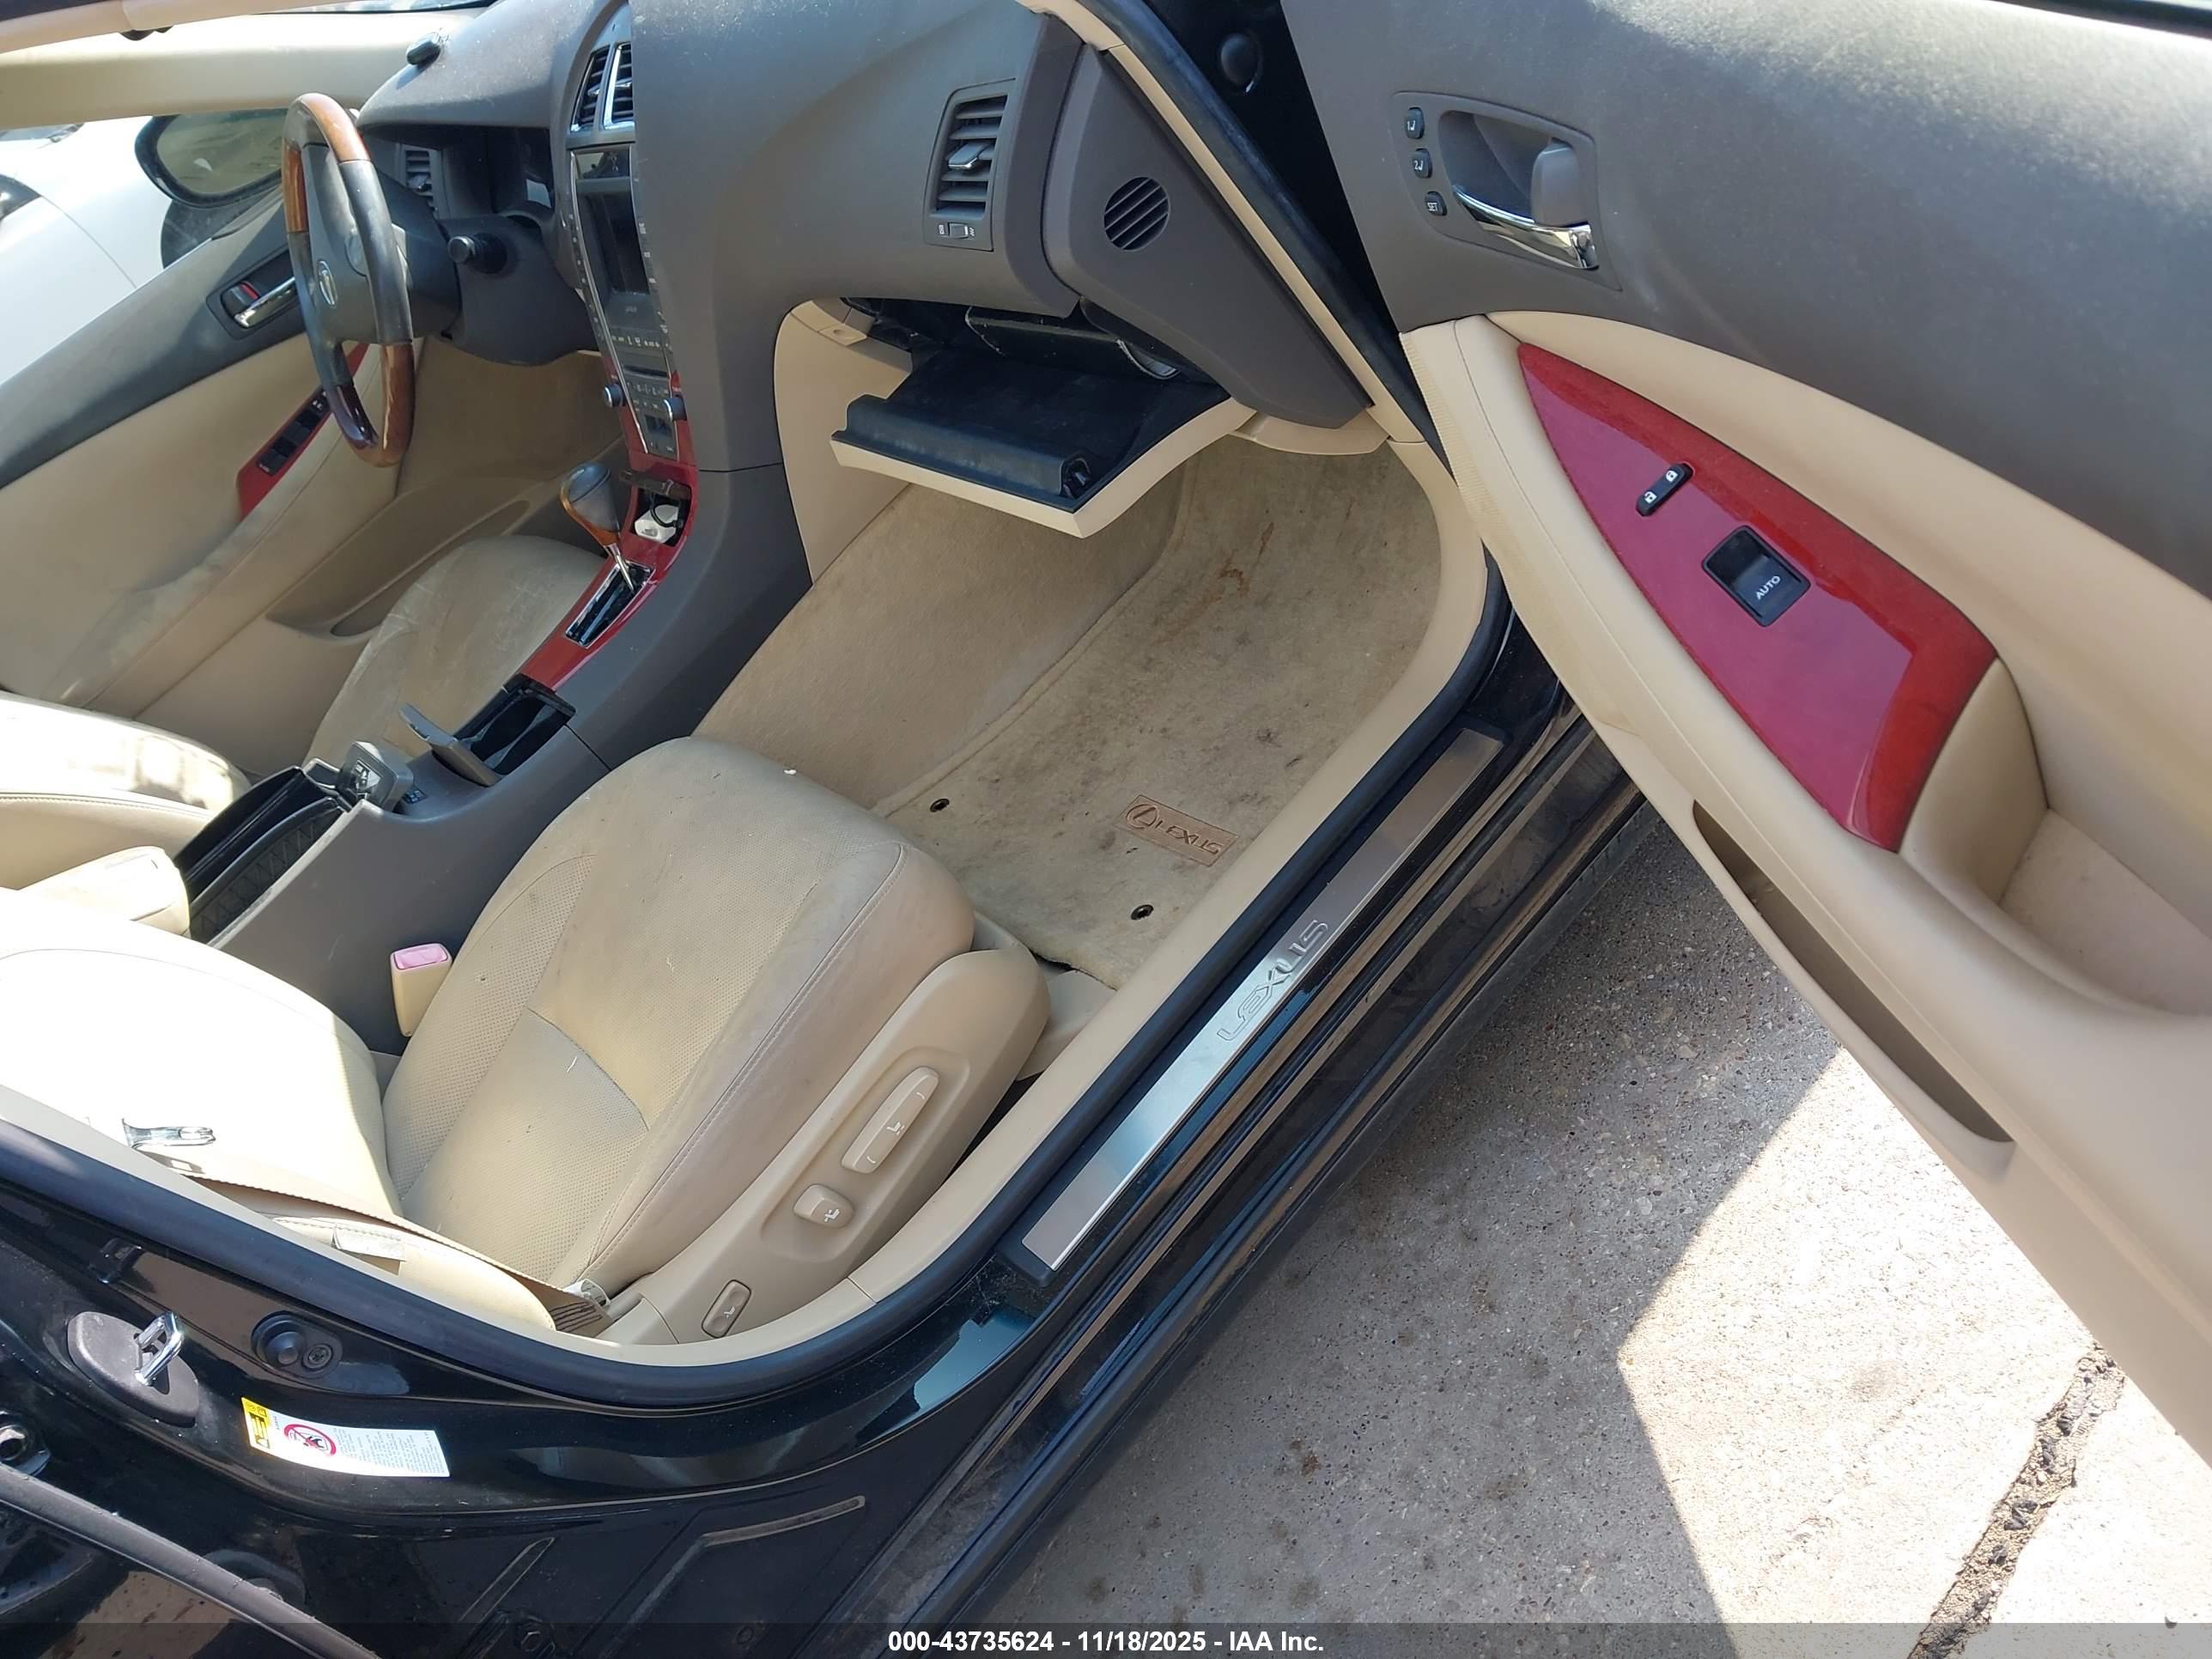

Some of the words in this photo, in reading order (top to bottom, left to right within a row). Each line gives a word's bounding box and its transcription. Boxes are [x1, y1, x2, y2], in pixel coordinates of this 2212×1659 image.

[1755, 575, 1781, 600] AUTO
[1155, 820, 1224, 855] LEXUS
[1216, 919, 1329, 1042] LEXUS
